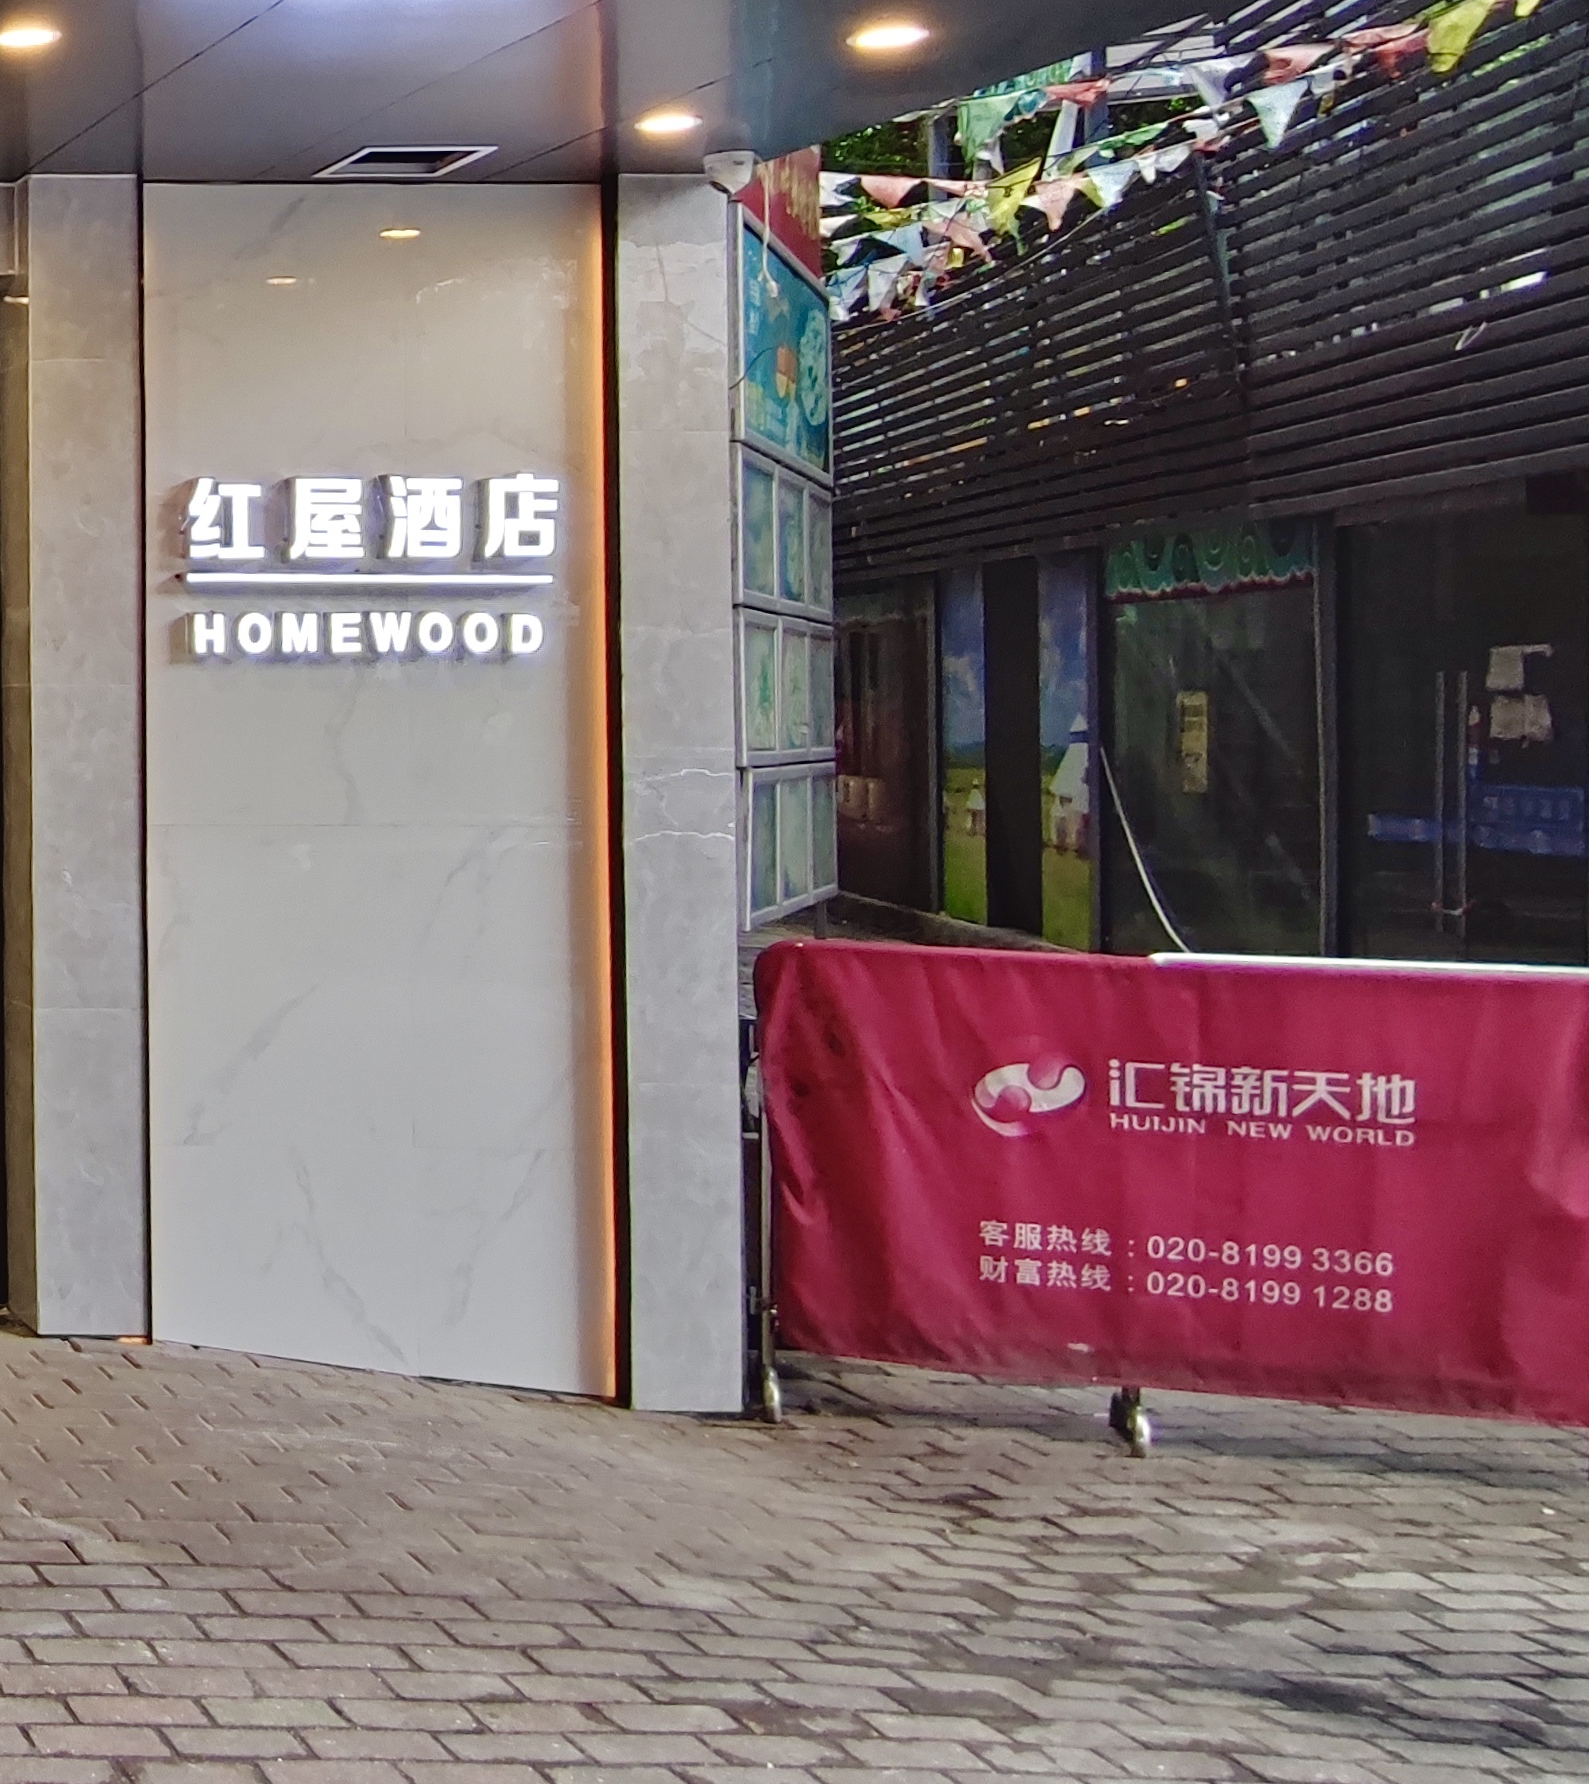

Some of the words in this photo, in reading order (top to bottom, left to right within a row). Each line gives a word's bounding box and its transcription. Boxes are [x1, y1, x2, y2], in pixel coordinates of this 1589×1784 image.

[187, 473, 560, 559] 红屋酒店
[192, 612, 544, 654] HOMEWOOD
[1108, 1057, 1418, 1126] 汇锦新天地
[1109, 1112, 1207, 1135] HUIJIN
[1227, 1120, 1292, 1141] NEW
[1306, 1123, 1416, 1148] WORLD
[1147, 1236, 1302, 1272] 020-8199
[1311, 1246, 1394, 1277] 3366
[1146, 1272, 1301, 1309] 020-8199
[1314, 1283, 1394, 1314] 1288
